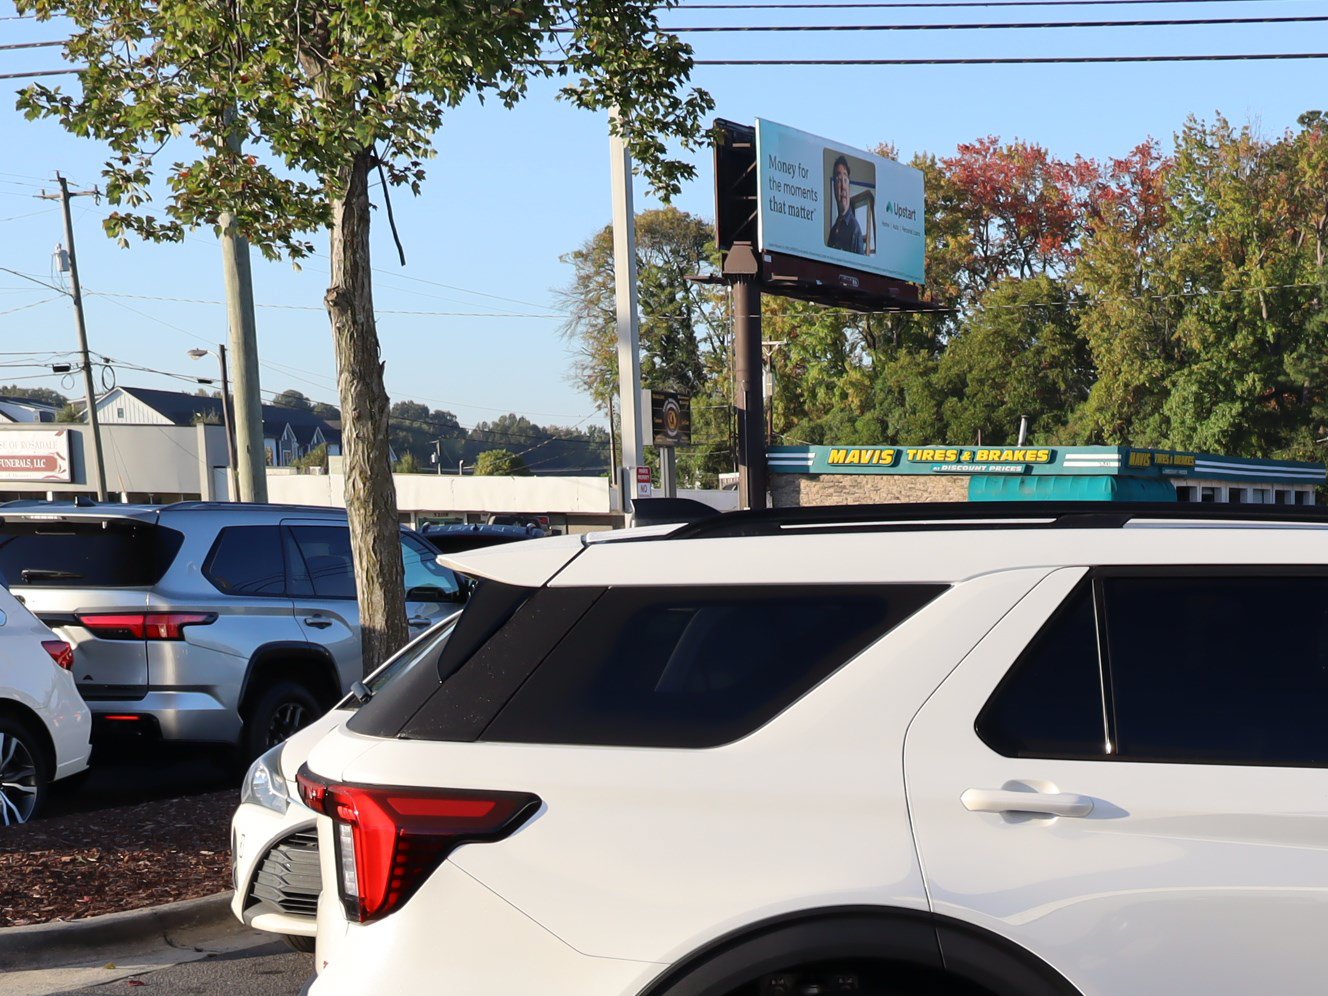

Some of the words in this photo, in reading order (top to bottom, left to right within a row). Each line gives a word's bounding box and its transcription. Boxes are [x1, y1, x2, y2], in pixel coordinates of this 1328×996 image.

[768, 154, 797, 179] Money
[798, 162, 809, 179] for
[768, 176, 782, 193] the
[783, 183, 819, 202] moments
[769, 195, 787, 215] that
[893, 201, 917, 221] Upstart
[33, 458, 46, 468] LLC
[827, 449, 895, 464] MAVIS
[906, 449, 958, 461] TIRES
[961, 450, 972, 461] &
[976, 449, 1051, 461] BRAKES
